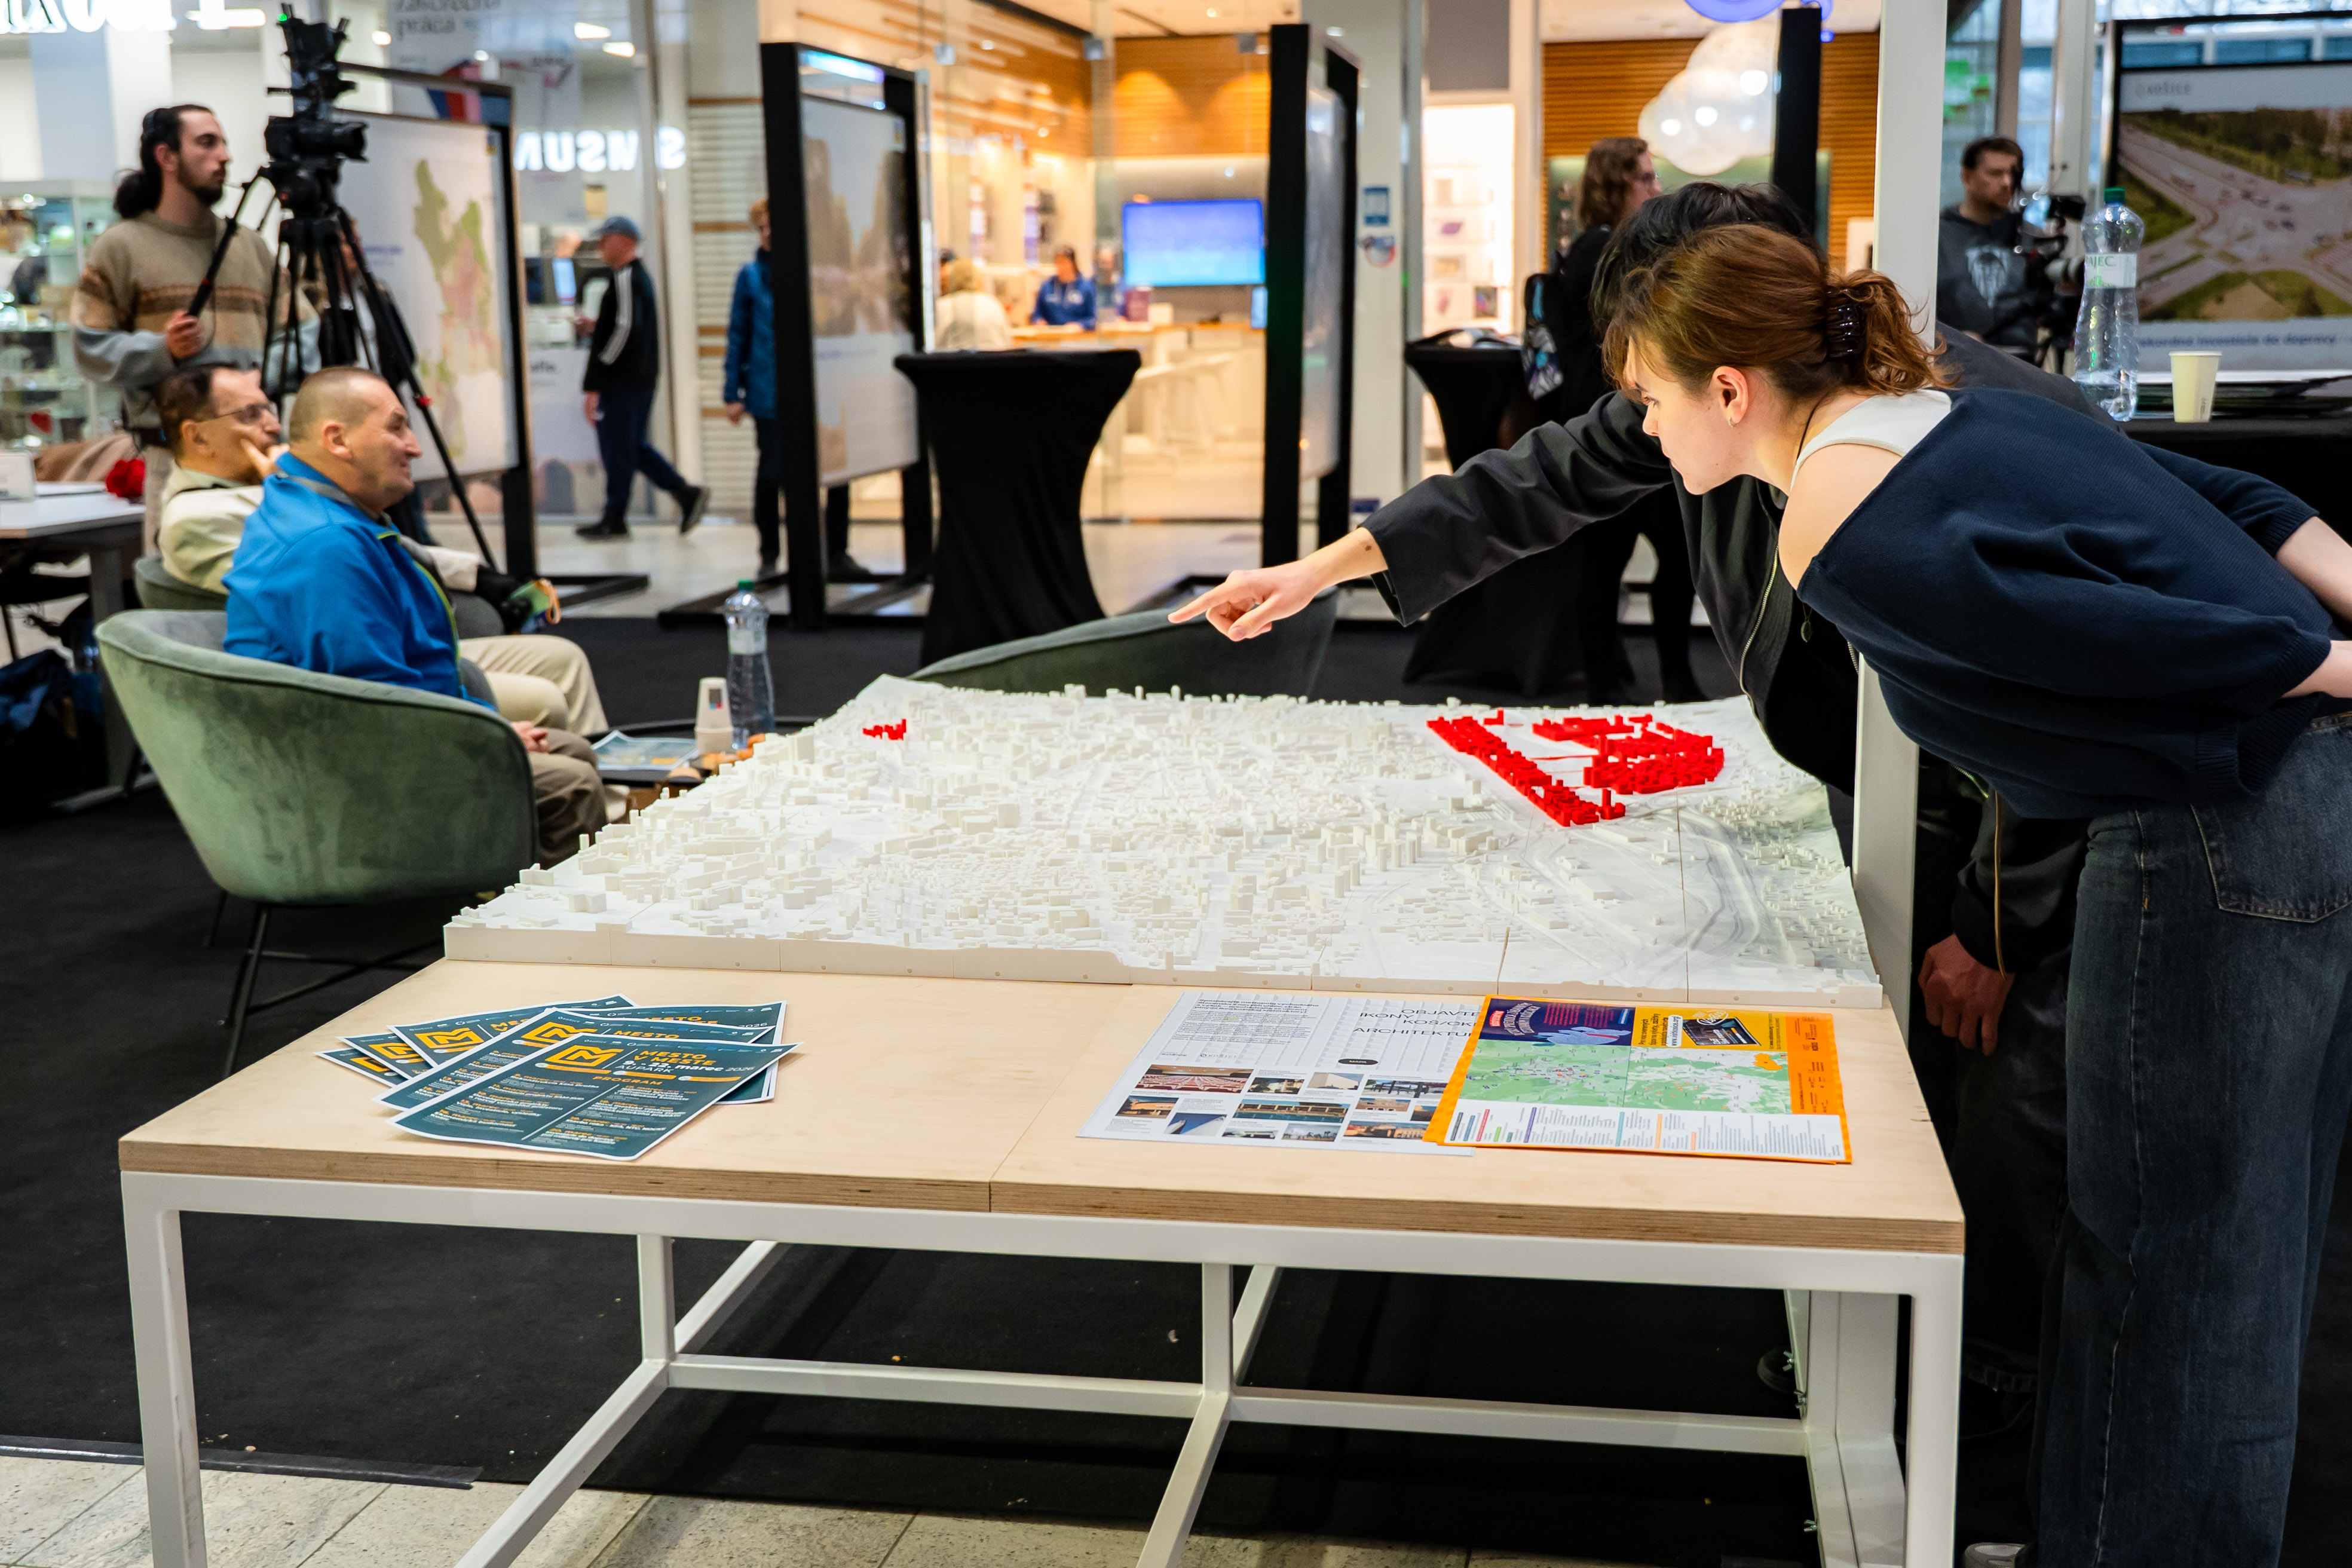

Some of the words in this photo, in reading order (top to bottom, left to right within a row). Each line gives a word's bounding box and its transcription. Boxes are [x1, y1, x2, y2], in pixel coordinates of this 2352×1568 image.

[613, 1030, 679, 1039] MESTO
[640, 1050, 707, 1060] MESTO
[650, 1056, 716, 1066] MESTE
[614, 1064, 674, 1074] AUPARK
[592, 1076, 663, 1085] PROGRAM
